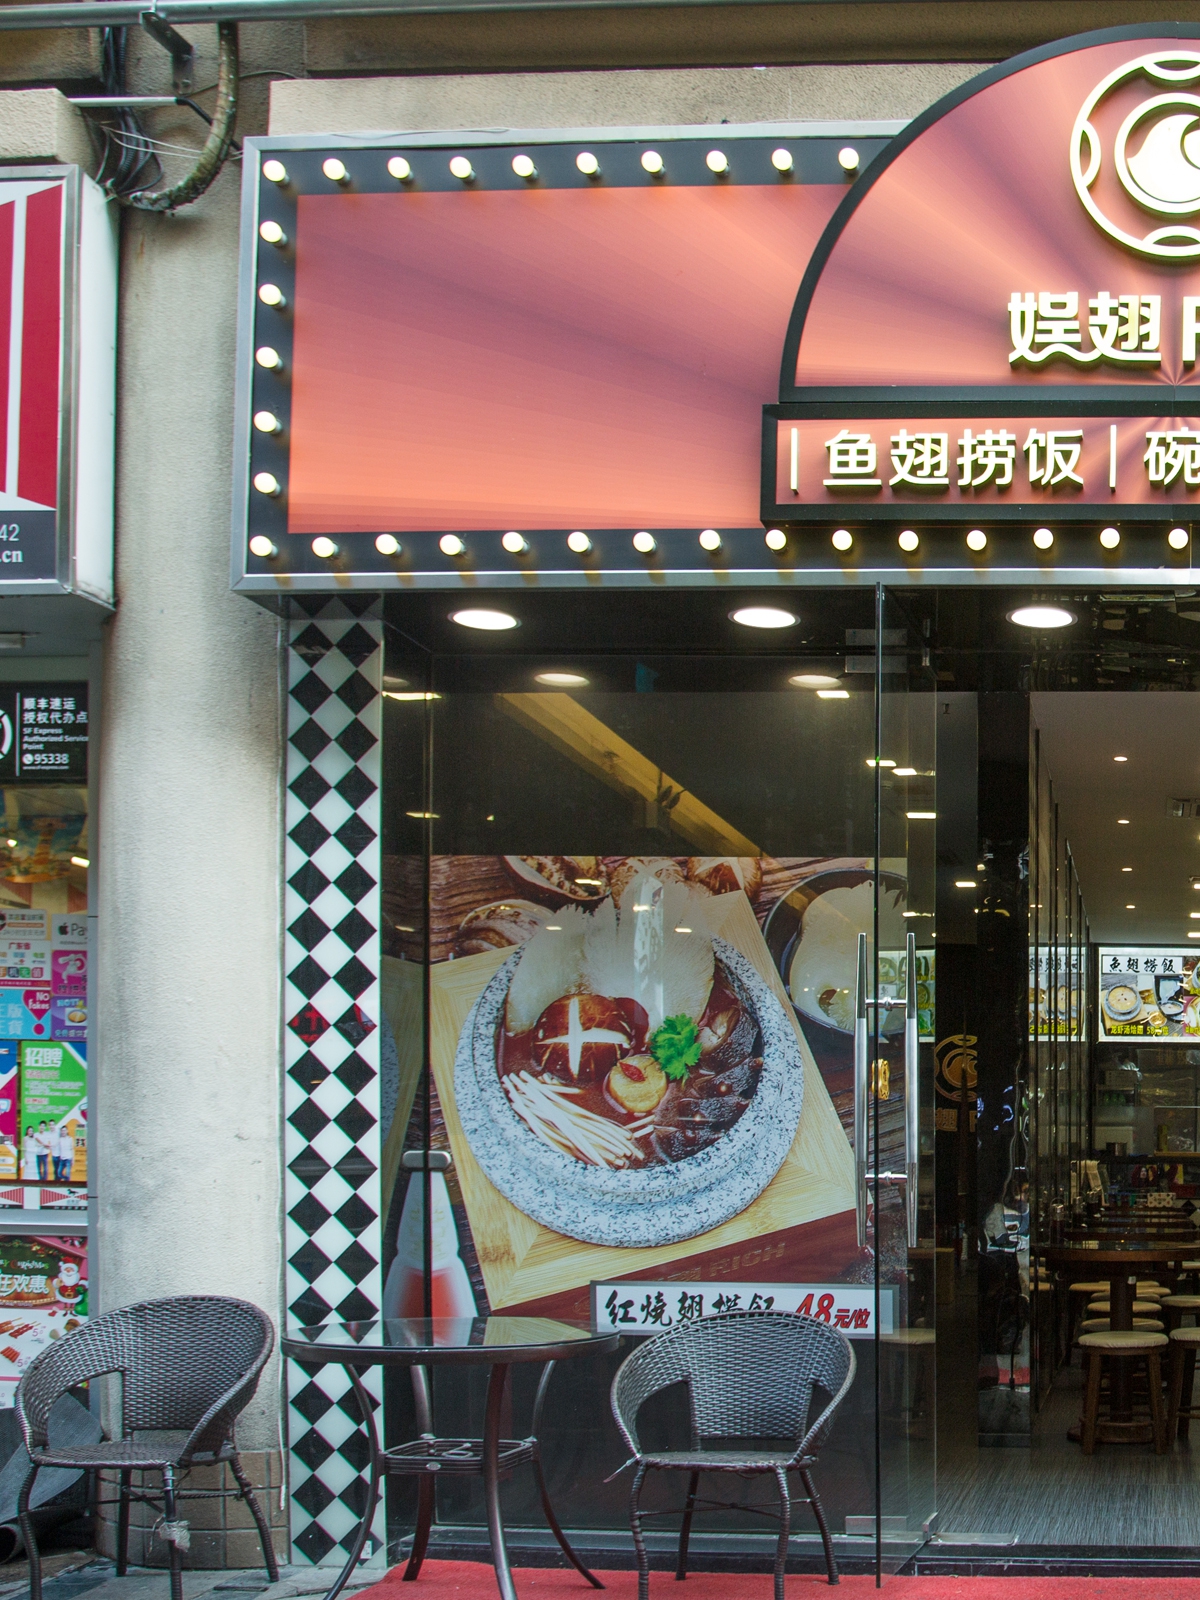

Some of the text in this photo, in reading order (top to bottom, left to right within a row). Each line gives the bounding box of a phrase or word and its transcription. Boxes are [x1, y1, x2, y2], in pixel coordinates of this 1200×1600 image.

[1008, 290, 1163, 366] 娱翅
[822, 428, 1086, 488] 鱼翅捞饭
[23, 697, 76, 710] 顺丰速运
[23, 711, 88, 724] 授权代办点
[33, 727, 63, 735] Express
[34, 753, 69, 764] 95338
[25, 1048, 63, 1067] 招聘
[709, 1242, 787, 1278] RICH
